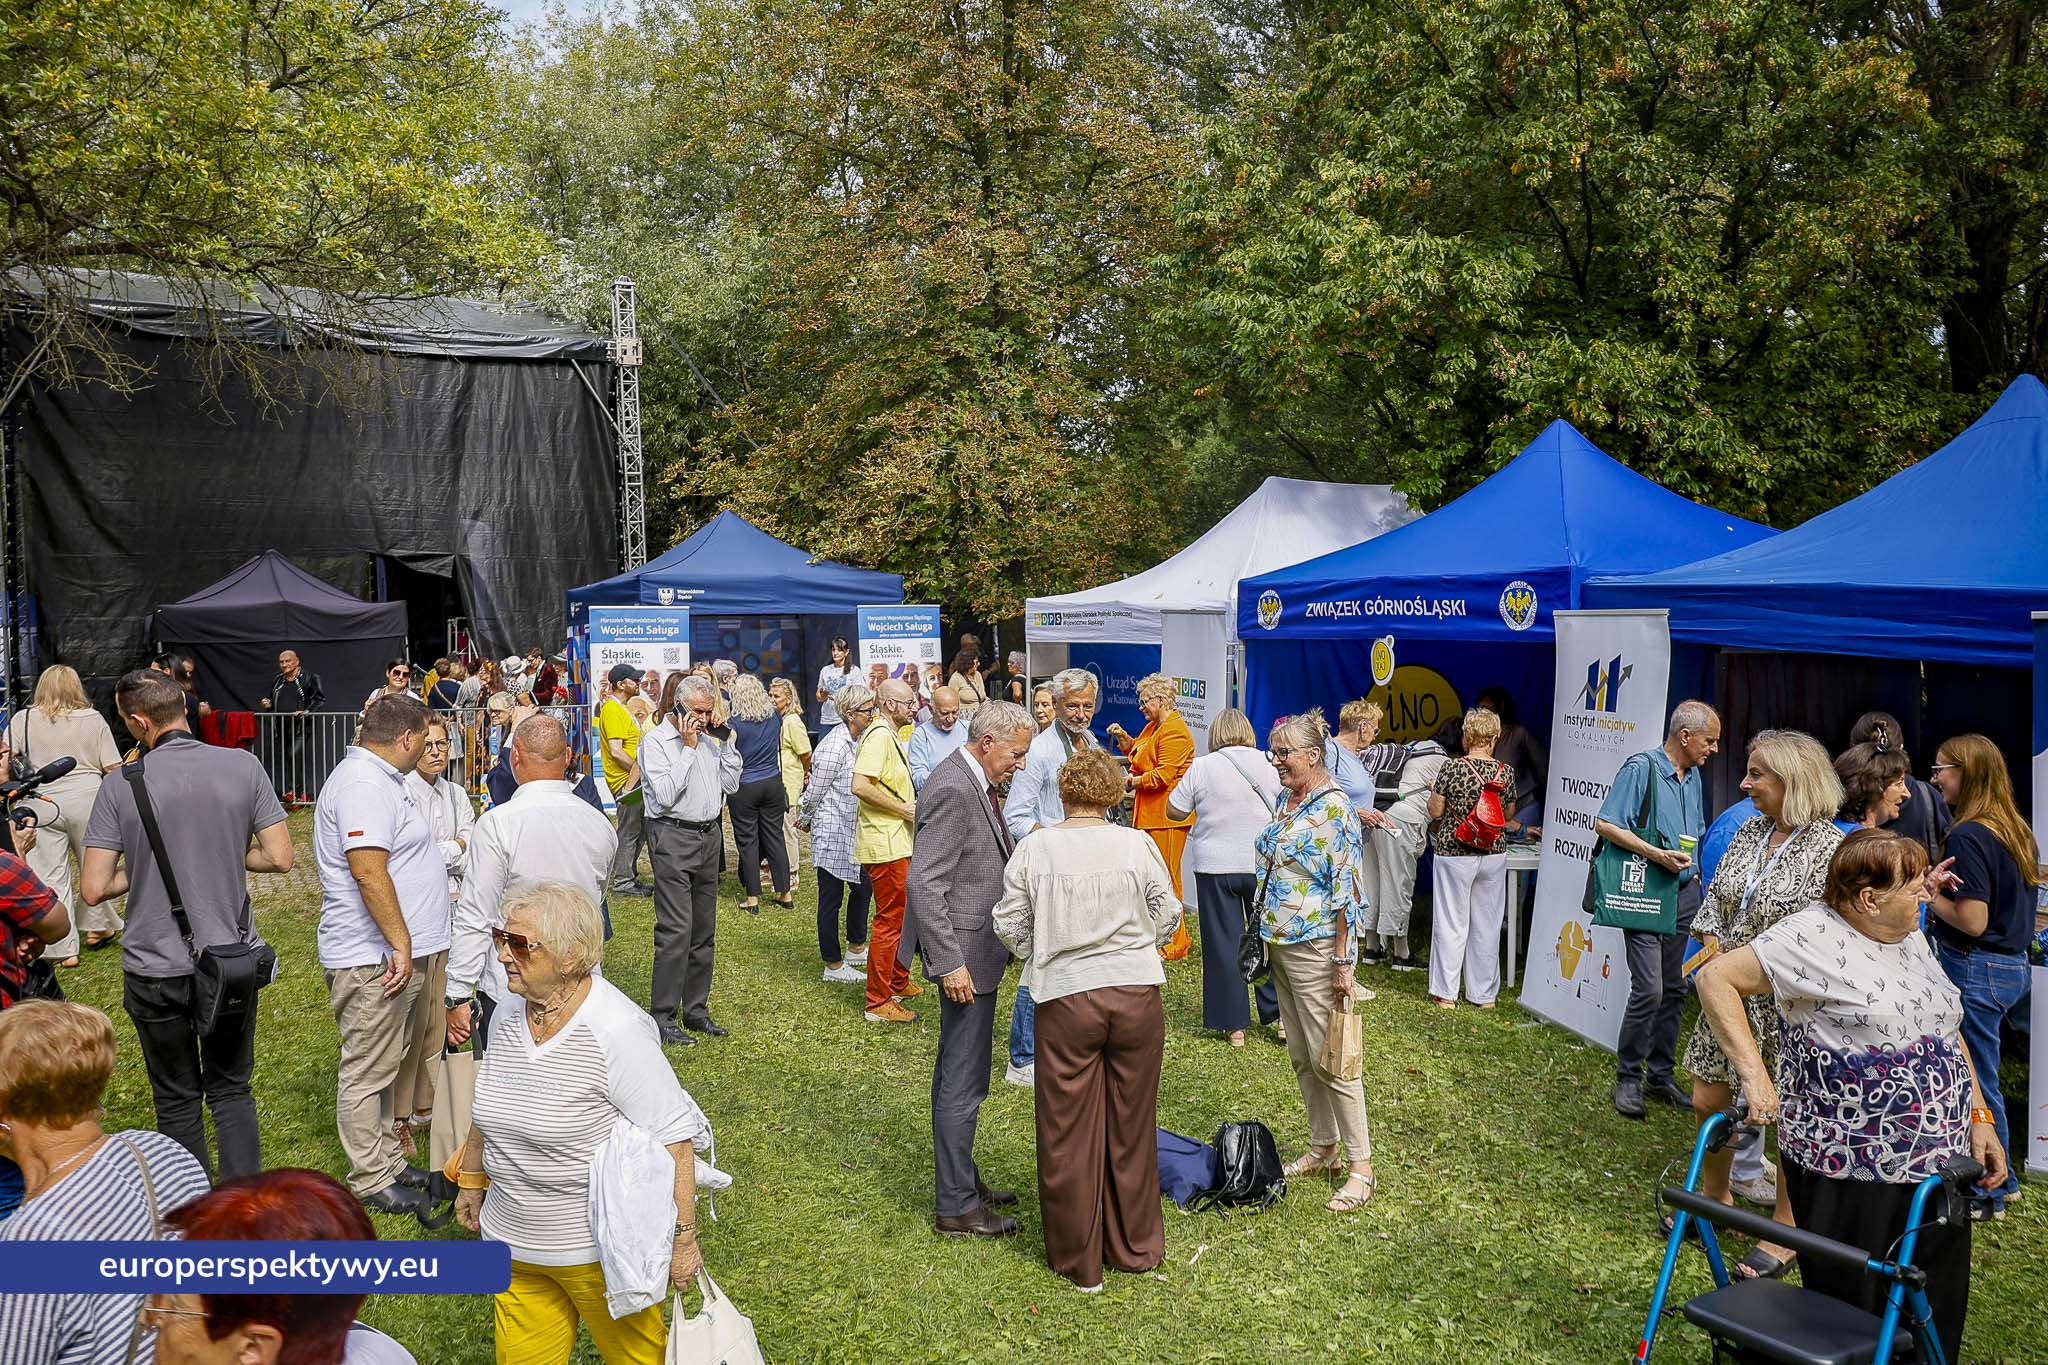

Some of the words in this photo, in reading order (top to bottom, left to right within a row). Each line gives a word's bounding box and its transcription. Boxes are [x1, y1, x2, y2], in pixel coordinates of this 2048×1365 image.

[1305, 601, 1361, 620] ZWIĄZEK
[1364, 595, 1467, 620] GÓRNOŚLĄSKI
[601, 625, 644, 636] Wojciech
[646, 625, 680, 636] Saługa
[868, 622, 904, 632] Wojciech
[905, 622, 933, 632] Saługa
[1106, 675, 1129, 693] Urząd
[1563, 713, 1596, 730] Instytut
[1597, 716, 1636, 735] Inicjatyw
[1568, 730, 1625, 746] LOKALNYCH
[1554, 807, 1596, 831] INSPIRU
